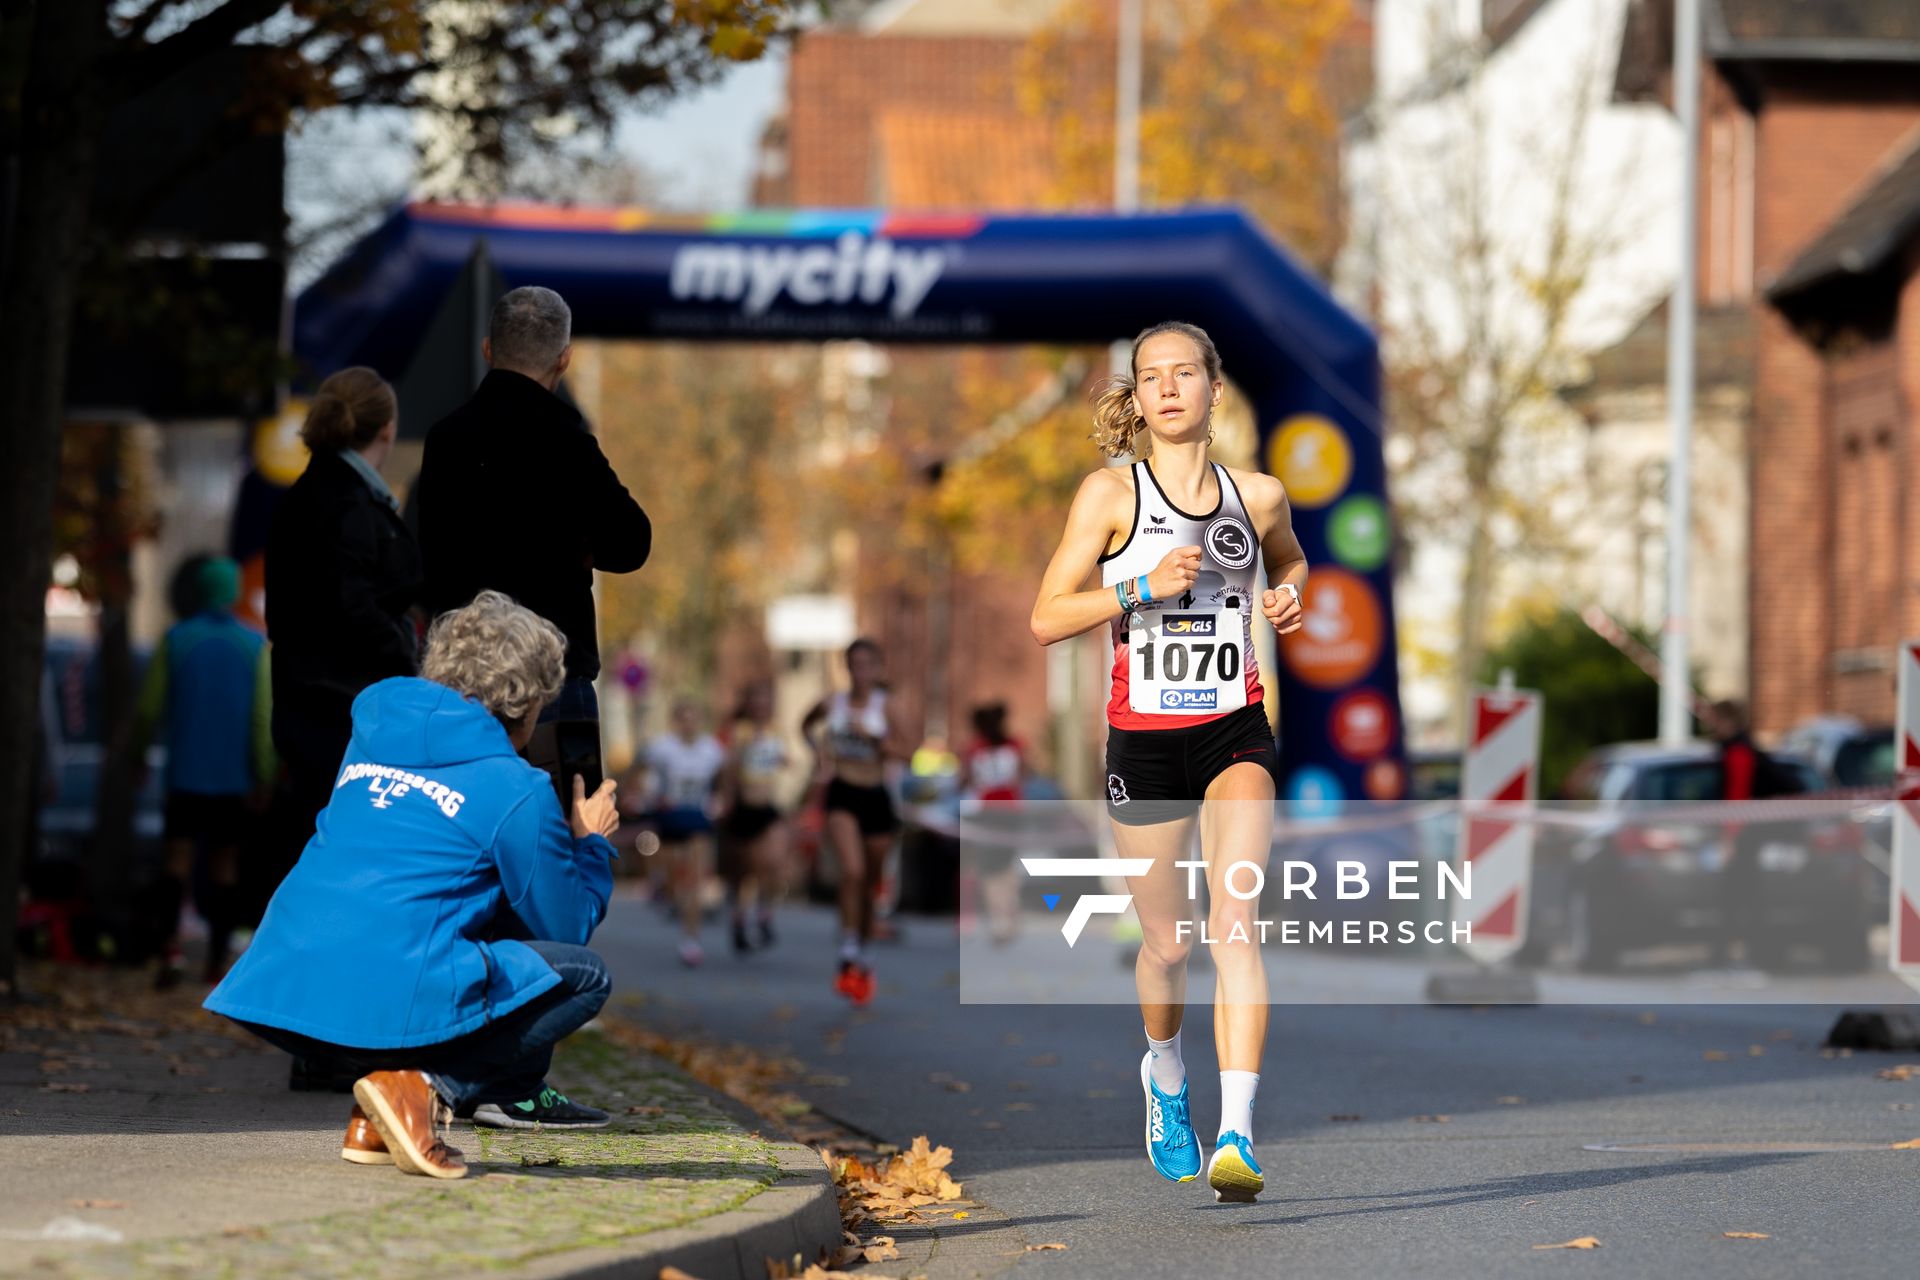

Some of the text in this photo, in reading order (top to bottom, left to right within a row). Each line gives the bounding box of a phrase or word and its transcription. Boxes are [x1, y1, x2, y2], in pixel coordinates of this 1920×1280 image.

[671, 231, 943, 316] mycity
[1143, 525, 1174, 535] erima
[1209, 585, 1241, 603] Henrika
[1191, 620, 1212, 632] GLS
[1136, 642, 1239, 681] 1070
[1183, 692, 1215, 702] PLAN
[336, 763, 465, 818] DONNERSBERG
[1151, 1095, 1165, 1142] HOKA
